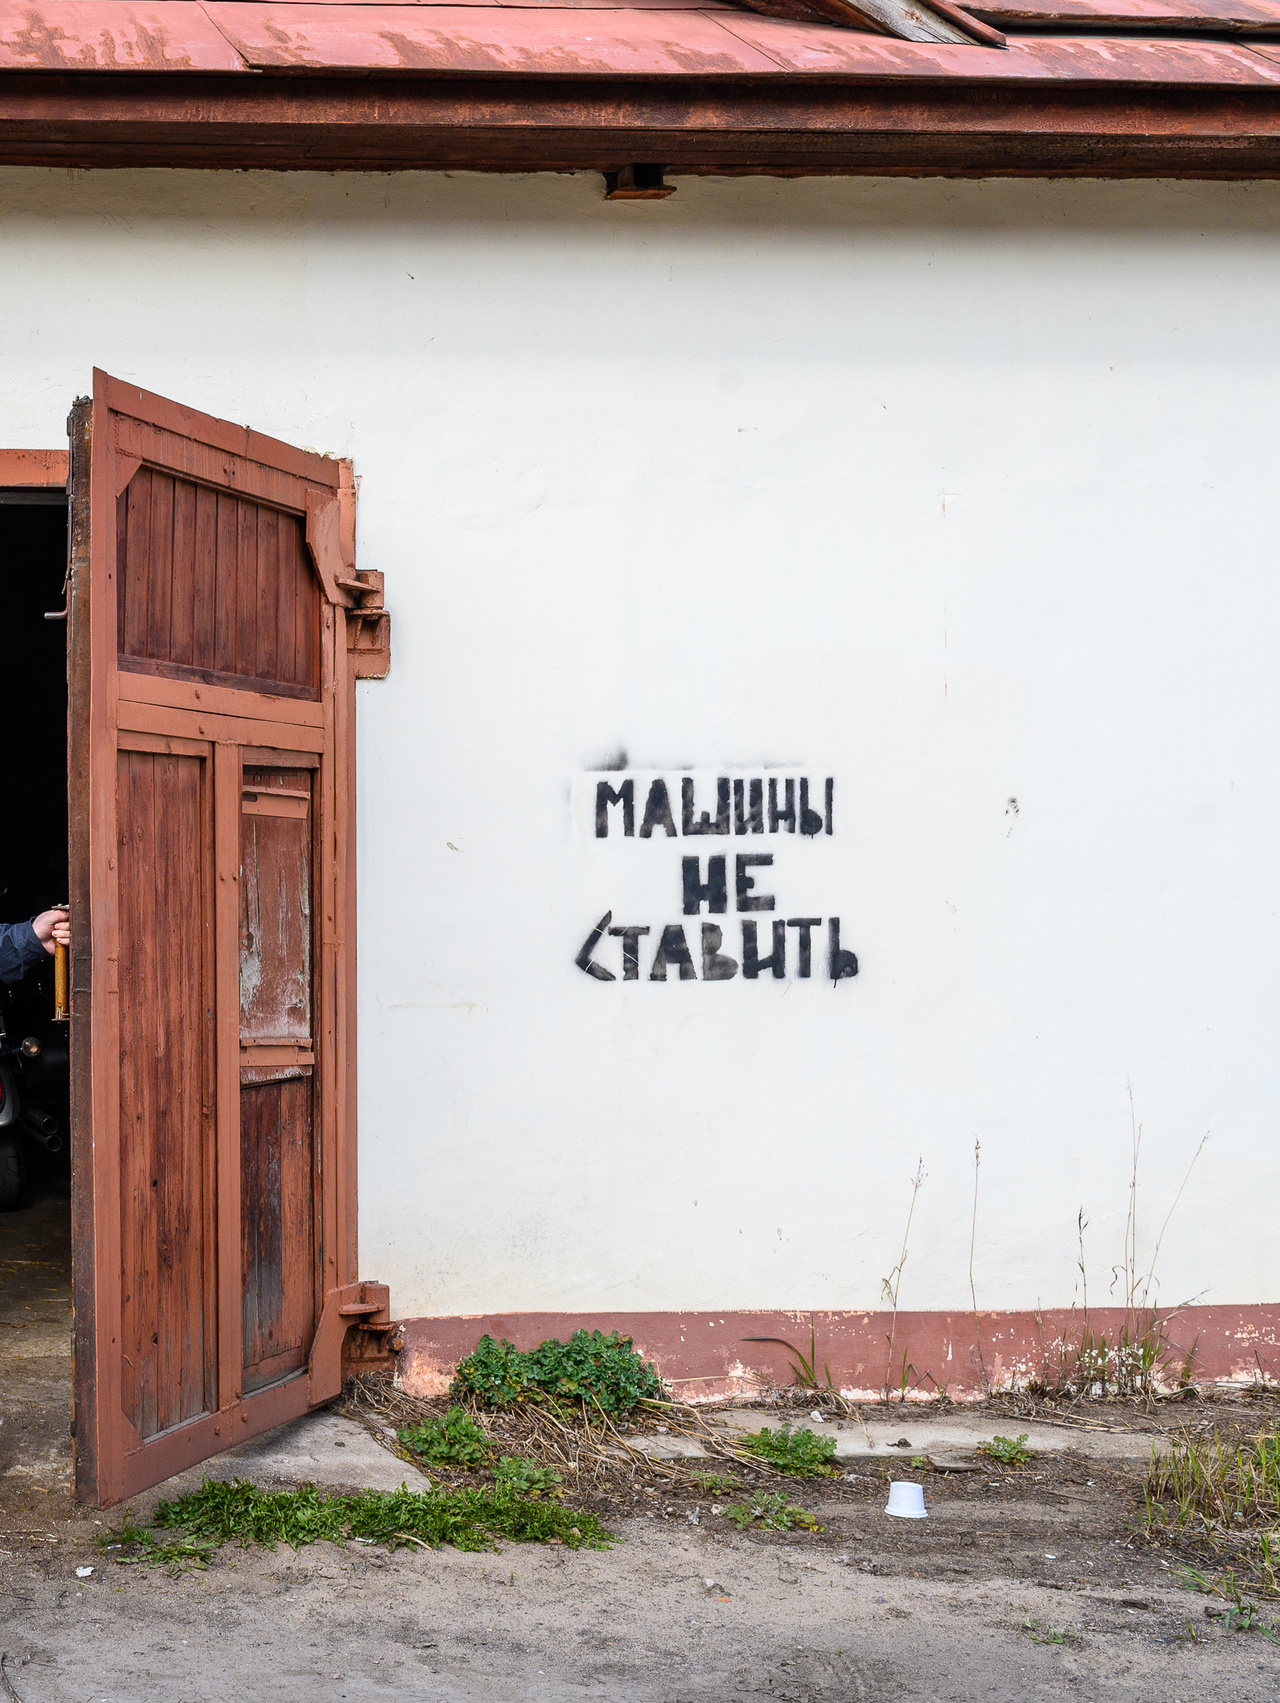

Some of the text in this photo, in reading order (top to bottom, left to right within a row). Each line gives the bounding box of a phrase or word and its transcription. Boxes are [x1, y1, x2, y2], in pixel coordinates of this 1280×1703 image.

[595, 777, 834, 838] МАШИНЫ
[681, 853, 776, 915] НЕ
[574, 909, 859, 984] СТАВИТЬ
